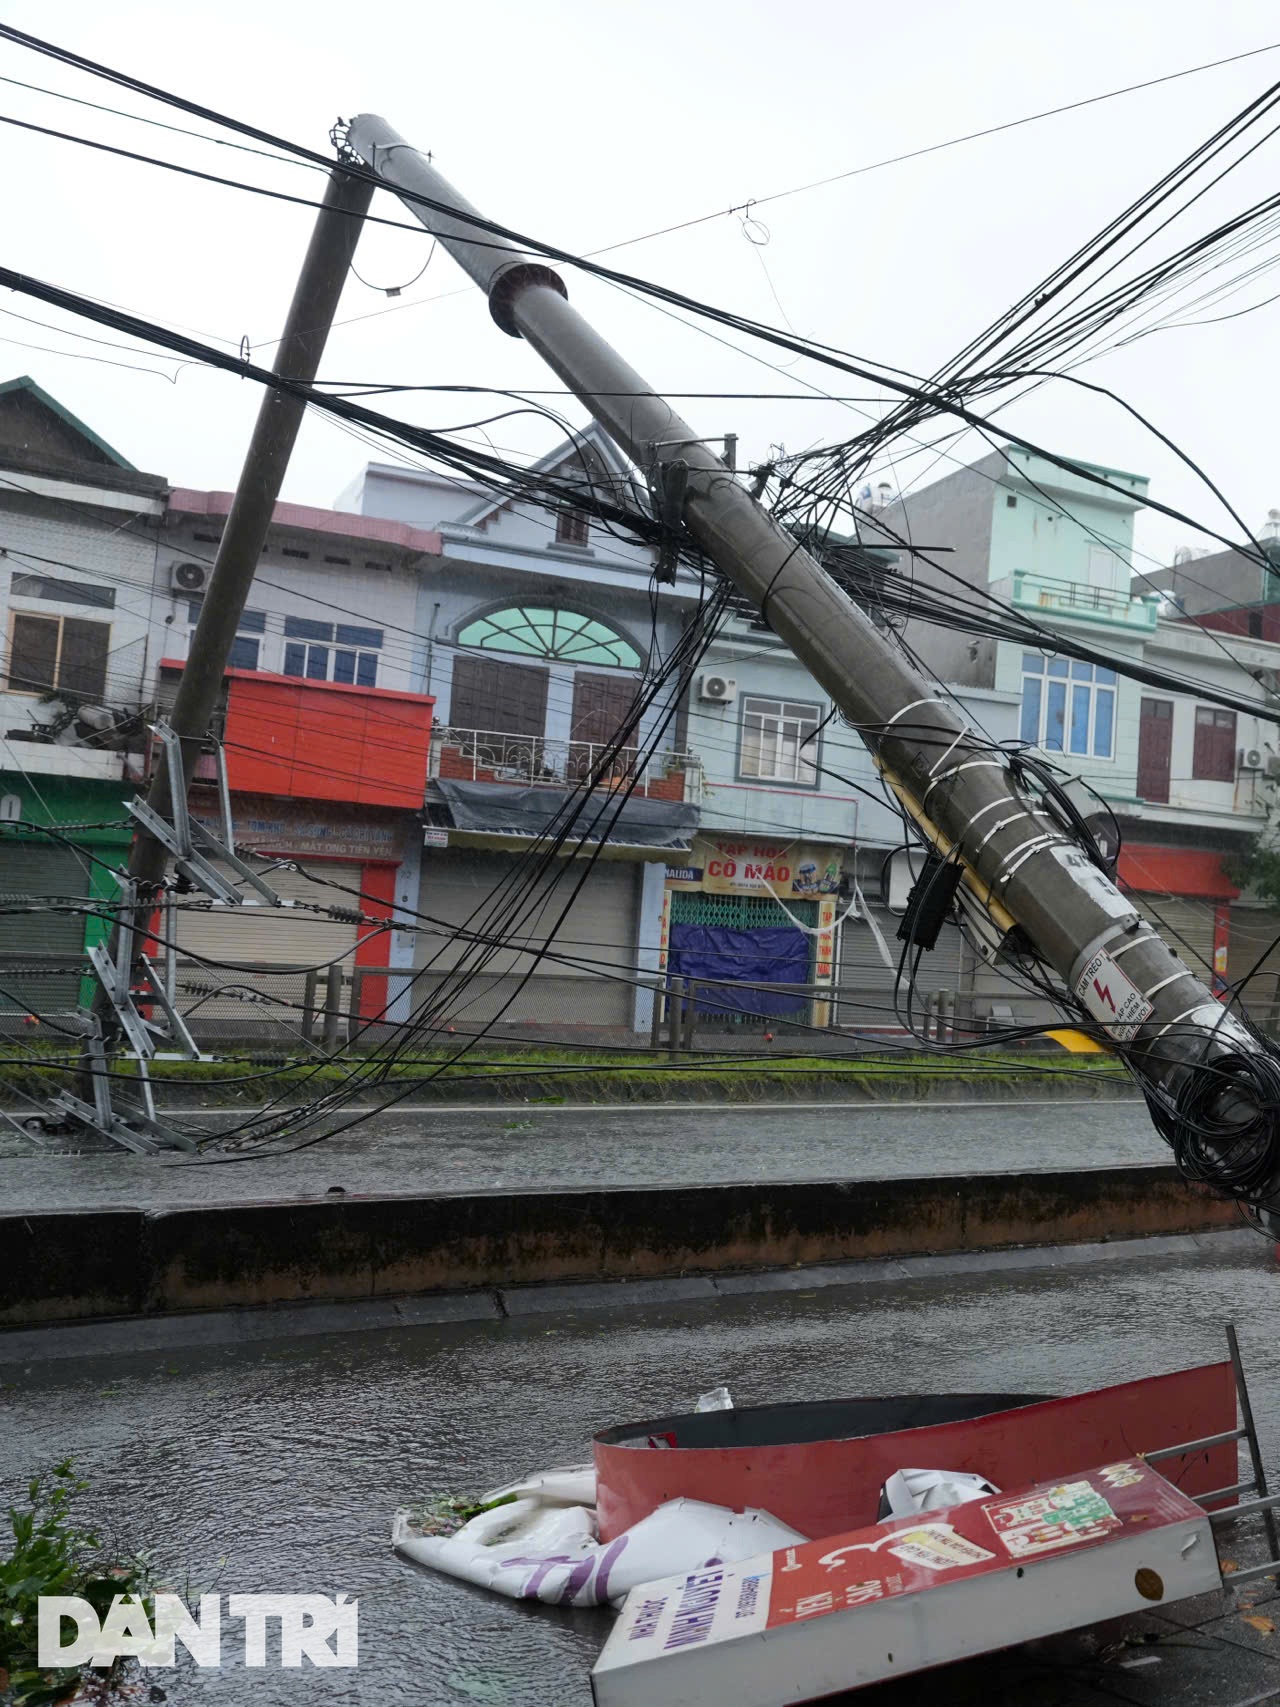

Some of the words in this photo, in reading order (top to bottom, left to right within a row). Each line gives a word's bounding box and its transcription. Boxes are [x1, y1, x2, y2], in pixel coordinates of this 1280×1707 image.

[708, 859, 737, 878] CÔ
[1124, 993, 1136, 1009] CAO
[674, 1570, 735, 1617] NGUYỆT
[635, 1597, 668, 1626] THUỐC
[664, 1612, 714, 1650] MINH
